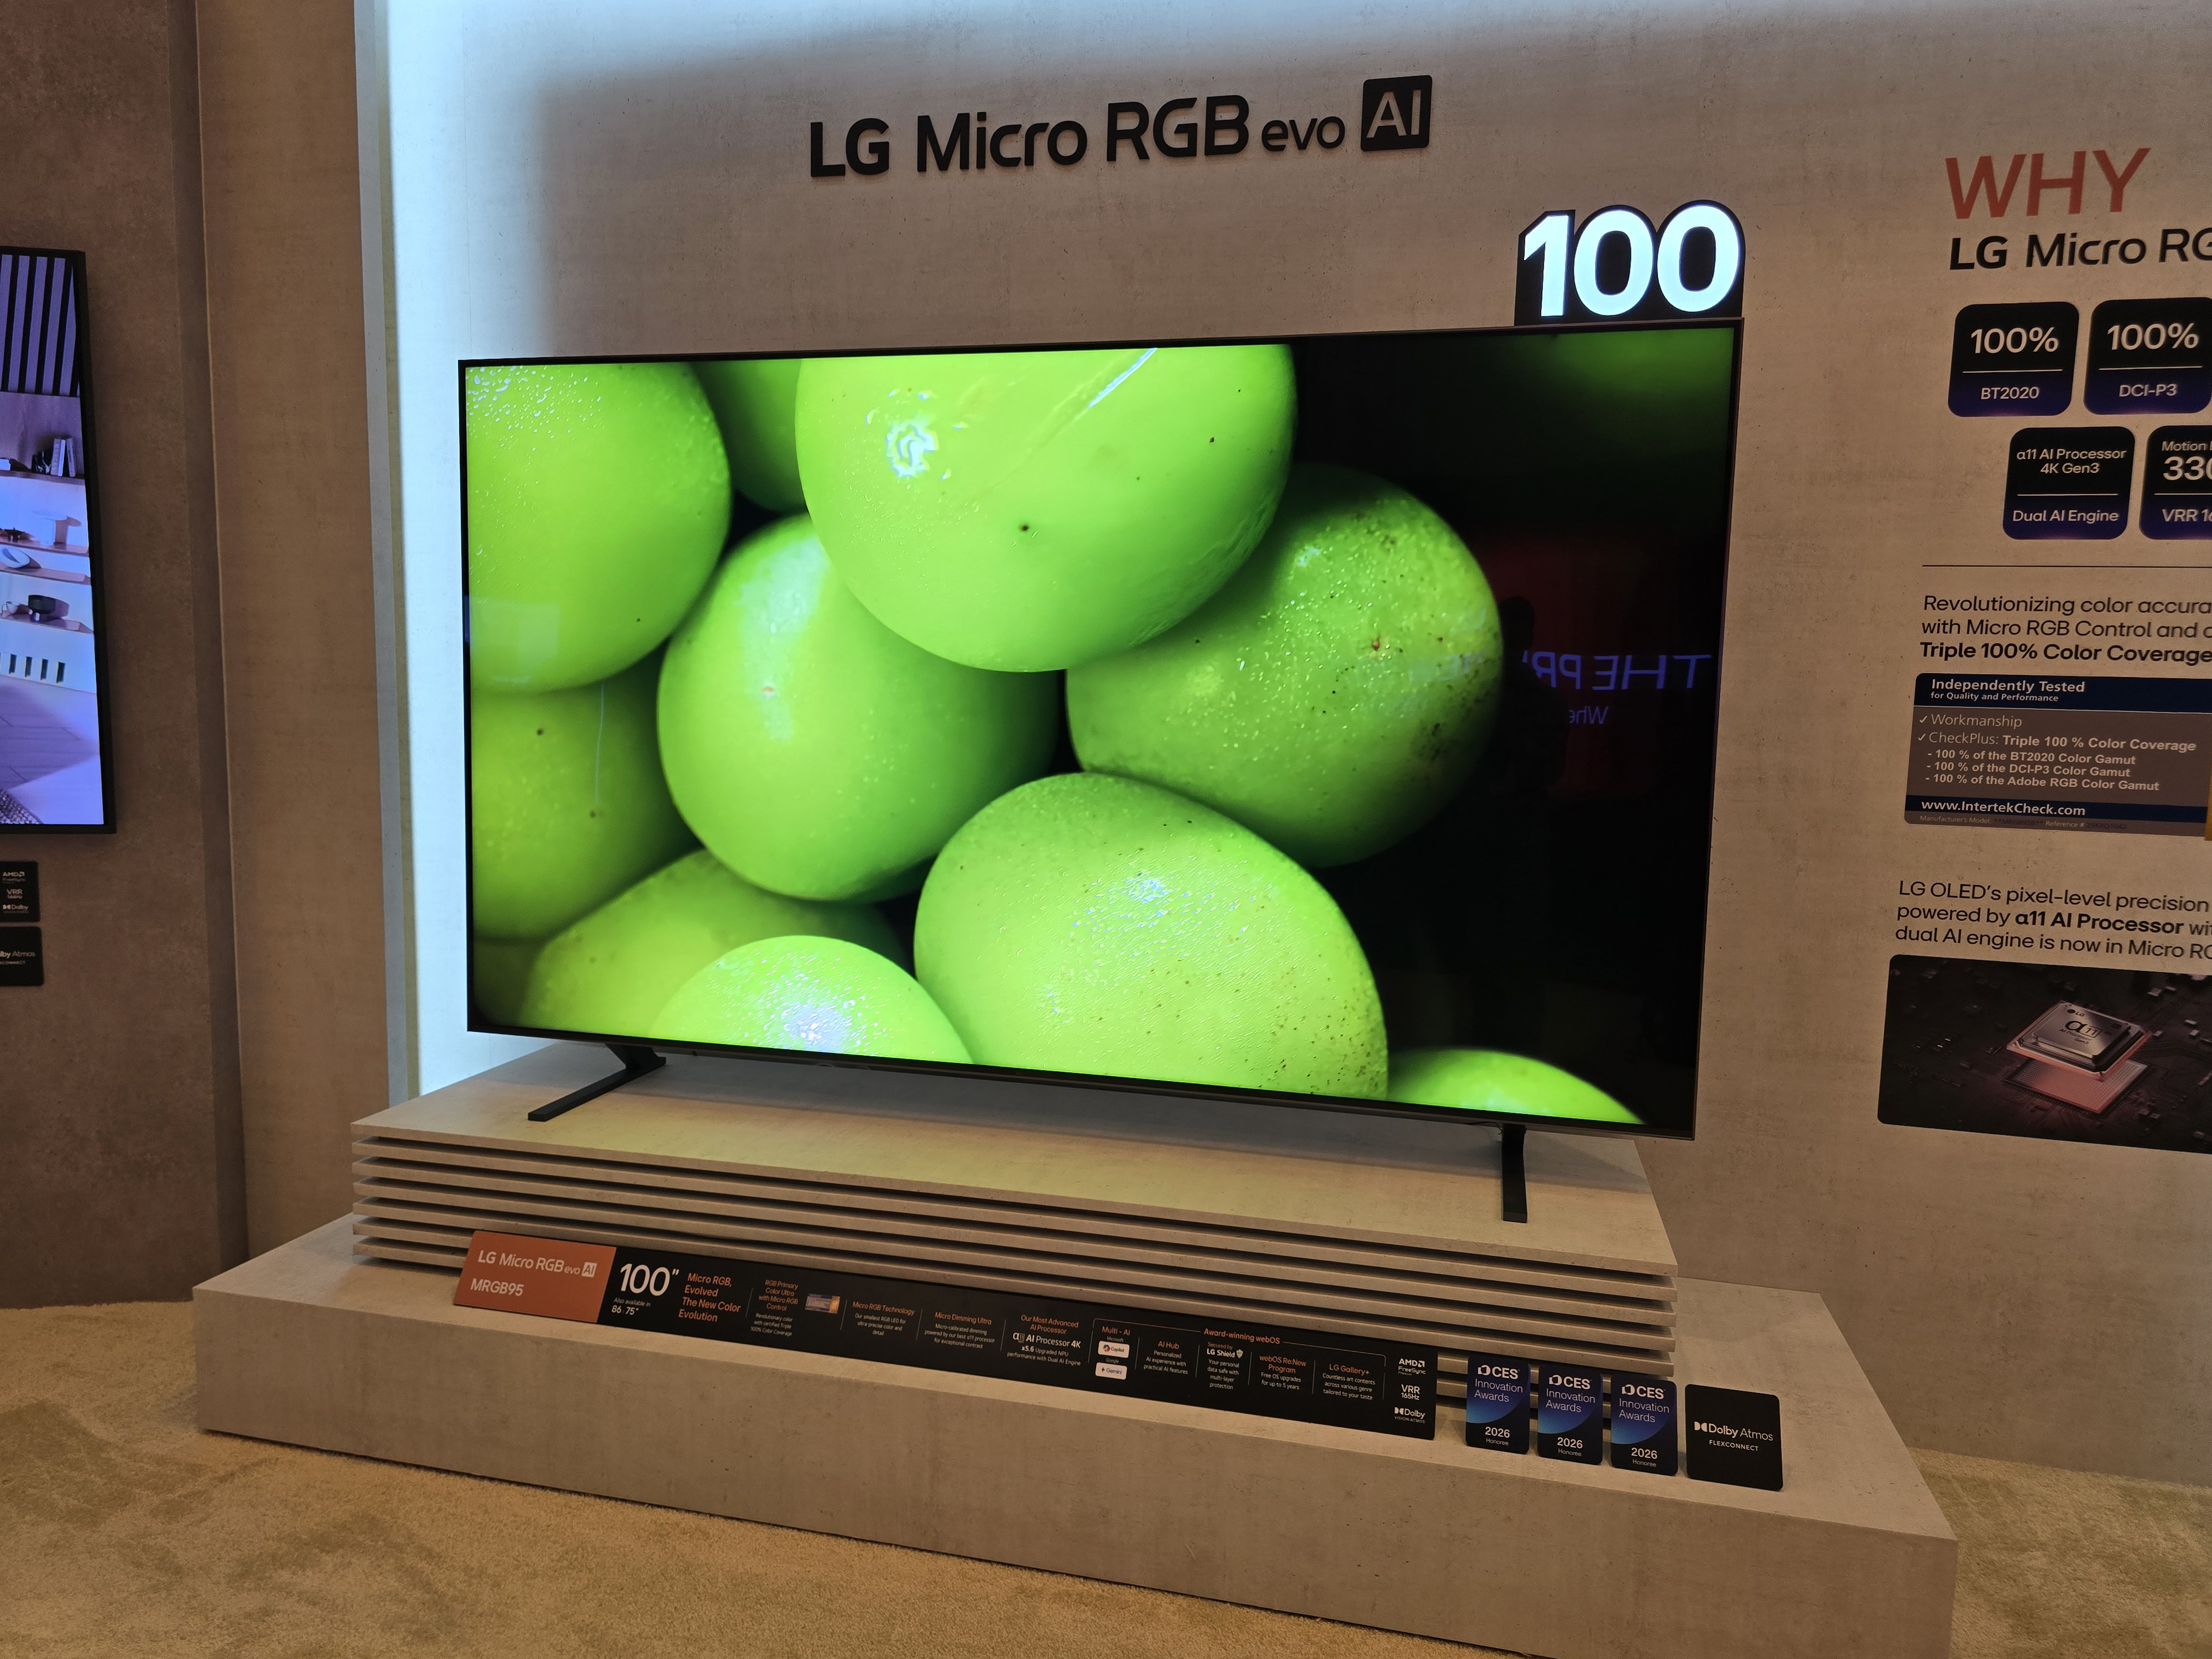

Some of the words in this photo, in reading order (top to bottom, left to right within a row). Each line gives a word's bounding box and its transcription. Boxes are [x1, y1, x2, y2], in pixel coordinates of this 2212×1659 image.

[810, 117, 890, 178] LG
[917, 112, 1088, 173] Micro
[1107, 95, 1250, 162] RGB
[1261, 115, 1346, 152] evo
[1365, 87, 1424, 140] AI
[1944, 147, 2151, 220] WHY
[1949, 235, 2008, 270] LG
[2026, 233, 2147, 268] Micro
[1524, 205, 1740, 317] 100
[1970, 326, 2059, 354] 100%
[2107, 322, 2199, 351] 100%
[1980, 387, 2039, 400] BT2020
[2119, 384, 2177, 398] DCI-P3
[2162, 441, 2206, 452] Motion
[2039, 449, 2053, 460] AI
[2057, 448, 2126, 460] Processor
[2040, 463, 2059, 474] 4K
[2062, 463, 2100, 474] Gen3
[2163, 457, 2212, 481] 33
[2013, 510, 2047, 521] Dual
[2049, 510, 2065, 521] AI
[2068, 510, 2119, 524] Engine
[2162, 509, 2199, 522] VRR
[1923, 596, 2075, 616] Revolutionizing
[2080, 598, 2133, 613] color
[1922, 619, 1961, 635] with
[1966, 619, 2021, 635] Micro
[2027, 620, 2070, 636] RGB
[2075, 620, 2152, 637] Control
[2157, 622, 2197, 638] and
[1920, 642, 1976, 661] Triple
[1981, 643, 2038, 659] 100%
[2043, 644, 2102, 661] Color
[2106, 645, 2212, 666] Coverage
[1932, 679, 2034, 694] Independently
[2039, 681, 2085, 692] Tested
[1947, 692, 1979, 701] Quality
[2002, 694, 2058, 702] Performance
[1931, 714, 2022, 729] Workmanship
[1929, 732, 1999, 745] CheckPlus:
[2002, 735, 2039, 749] Triple
[2044, 737, 2067, 748] 100
[2071, 738, 2084, 748] %
[2088, 738, 2126, 750] Color
[2130, 739, 2197, 753] Coverage
[1935, 750, 1955, 759] 100
[1958, 750, 1970, 759] %
[1973, 751, 1985, 760] of
[1988, 752, 2007, 760] the
[2010, 752, 2055, 762] BT2020
[2058, 753, 2092, 763] Color
[2095, 754, 2136, 765] Gamut
[1934, 762, 1954, 771] 100
[1958, 763, 1969, 771] %
[1972, 763, 1984, 773] of
[1987, 764, 2006, 773] the
[2009, 764, 2049, 774] DCI-P3
[2053, 765, 2086, 775] Color
[2090, 766, 2130, 777] Gamut
[1933, 774, 1953, 783] 100
[1956, 775, 1968, 784] %
[1971, 775, 1983, 785] of
[1986, 776, 2005, 785] the
[2007, 776, 2047, 787] Adobe
[2050, 778, 2078, 787] RGB
[2081, 779, 2115, 789] Color
[2119, 780, 2159, 791] Gamut
[1922, 800, 2085, 816] www.IntertekCheck.com
[1900, 880, 1926, 896] LG
[2006, 888, 2110, 907] pixel-level
[2116, 894, 2209, 913] precision
[1897, 905, 1981, 922] powered
[1986, 909, 2010, 927] by
[2051, 912, 2072, 927] AI
[2077, 914, 2183, 934] Processor
[1895, 926, 1938, 942] dual
[1942, 928, 1961, 943] AI
[1966, 931, 2034, 950] engine
[2039, 934, 2054, 950] is
[2059, 937, 2100, 953] now
[2106, 938, 2123, 953] in
[2128, 940, 2184, 958] Micro
[477, 1250, 497, 1264] LG
[499, 1253, 534, 1270] Micro
[536, 1258, 564, 1272] RGB
[564, 1266, 580, 1275] evo
[687, 1272, 711, 1285] Micro
[712, 1276, 732, 1287] RGB,
[470, 1278, 524, 1297] MRGB95
[684, 1285, 719, 1297] Evolved
[612, 1305, 622, 1314] 86
[682, 1296, 698, 1308] The
[698, 1298, 716, 1310] New
[718, 1302, 741, 1313] Color
[882, 1305, 915, 1316] Technology
[679, 1308, 718, 1322] Evolution
[1026, 1334, 1034, 1343] AI
[1036, 1337, 1070, 1347] Processor
[1204, 1328, 1254, 1343] Award-winning
[1256, 1334, 1280, 1344] webOS
[1217, 1349, 1235, 1358] Shield
[1260, 1355, 1282, 1364] webOS
[1269, 1364, 1296, 1374] Program
[1399, 1358, 1418, 1367] AMD
[1340, 1365, 1369, 1376] Gallery+
[1398, 1366, 1426, 1375] FreeSync
[1492, 1366, 1519, 1379] CES
[1401, 1384, 1420, 1394] VRR
[1474, 1379, 1523, 1394] Innovation
[1563, 1376, 1590, 1390] CES
[1474, 1390, 1509, 1402] Awards
[1546, 1388, 1595, 1404] Innovation
[1636, 1386, 1664, 1399] CES
[1546, 1400, 1582, 1413] Awards
[1619, 1399, 1670, 1413] Innovation
[1405, 1409, 1426, 1419] Dolby
[1619, 1410, 1655, 1423] Awards
[1485, 1427, 1510, 1438] 2026
[1708, 1423, 1738, 1438] Dolby
[1740, 1428, 1773, 1441] Atmos
[1485, 1437, 1509, 1446] Honoree
[1557, 1437, 1583, 1449] 2026
[1709, 1439, 1759, 1452] FLEXCONNECT
[1558, 1448, 1582, 1457] Honoree
[1631, 1447, 1658, 1459] 2026
[1632, 1458, 1657, 1468] Honoree
